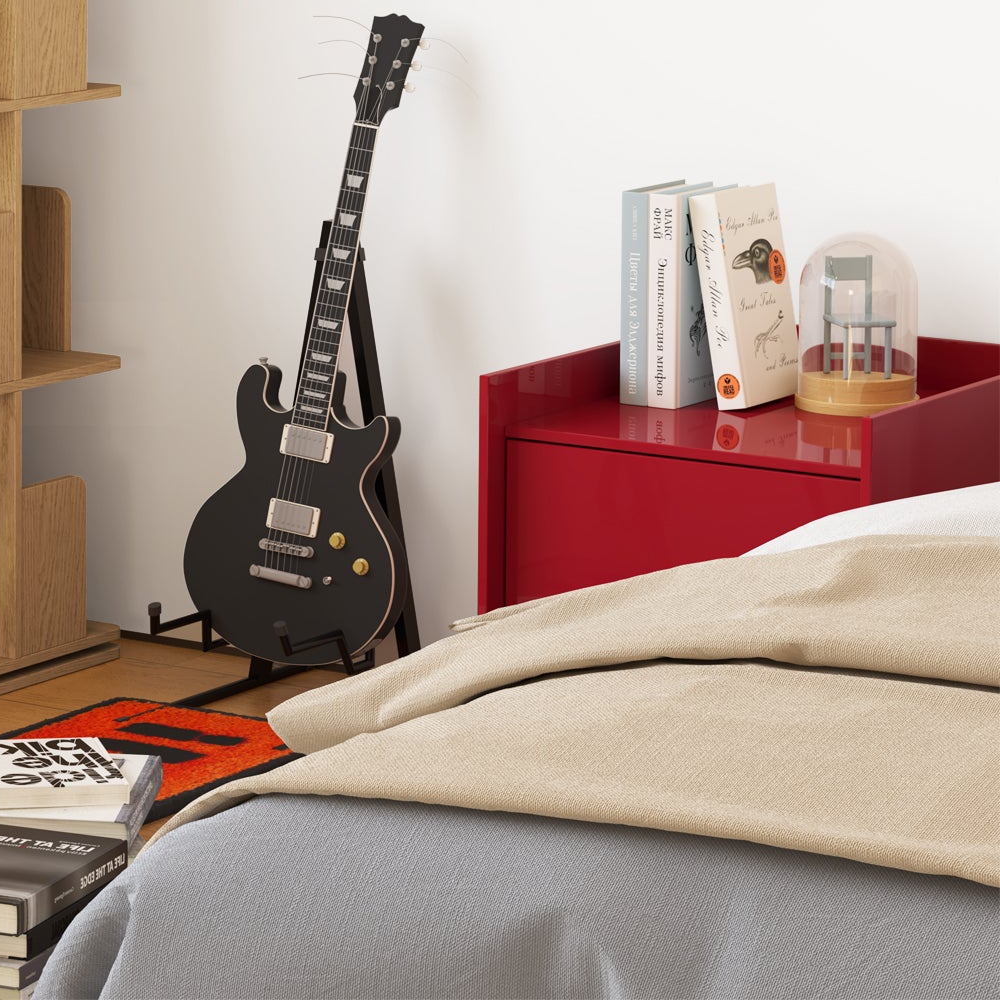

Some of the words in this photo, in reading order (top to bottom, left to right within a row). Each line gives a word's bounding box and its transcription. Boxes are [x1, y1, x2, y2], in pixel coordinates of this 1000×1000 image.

[653, 207, 662, 240] ФРАЙ
[664, 208, 673, 240] МАКС
[768, 207, 778, 223] Poe
[629, 252, 641, 291] Цветы
[698, 229, 715, 271] Edgar
[708, 275, 723, 318] Allan
[628, 295, 640, 317] для
[657, 258, 668, 351] Энциклопедия
[627, 320, 641, 395] Элджернона
[655, 355, 668, 397] мифов
